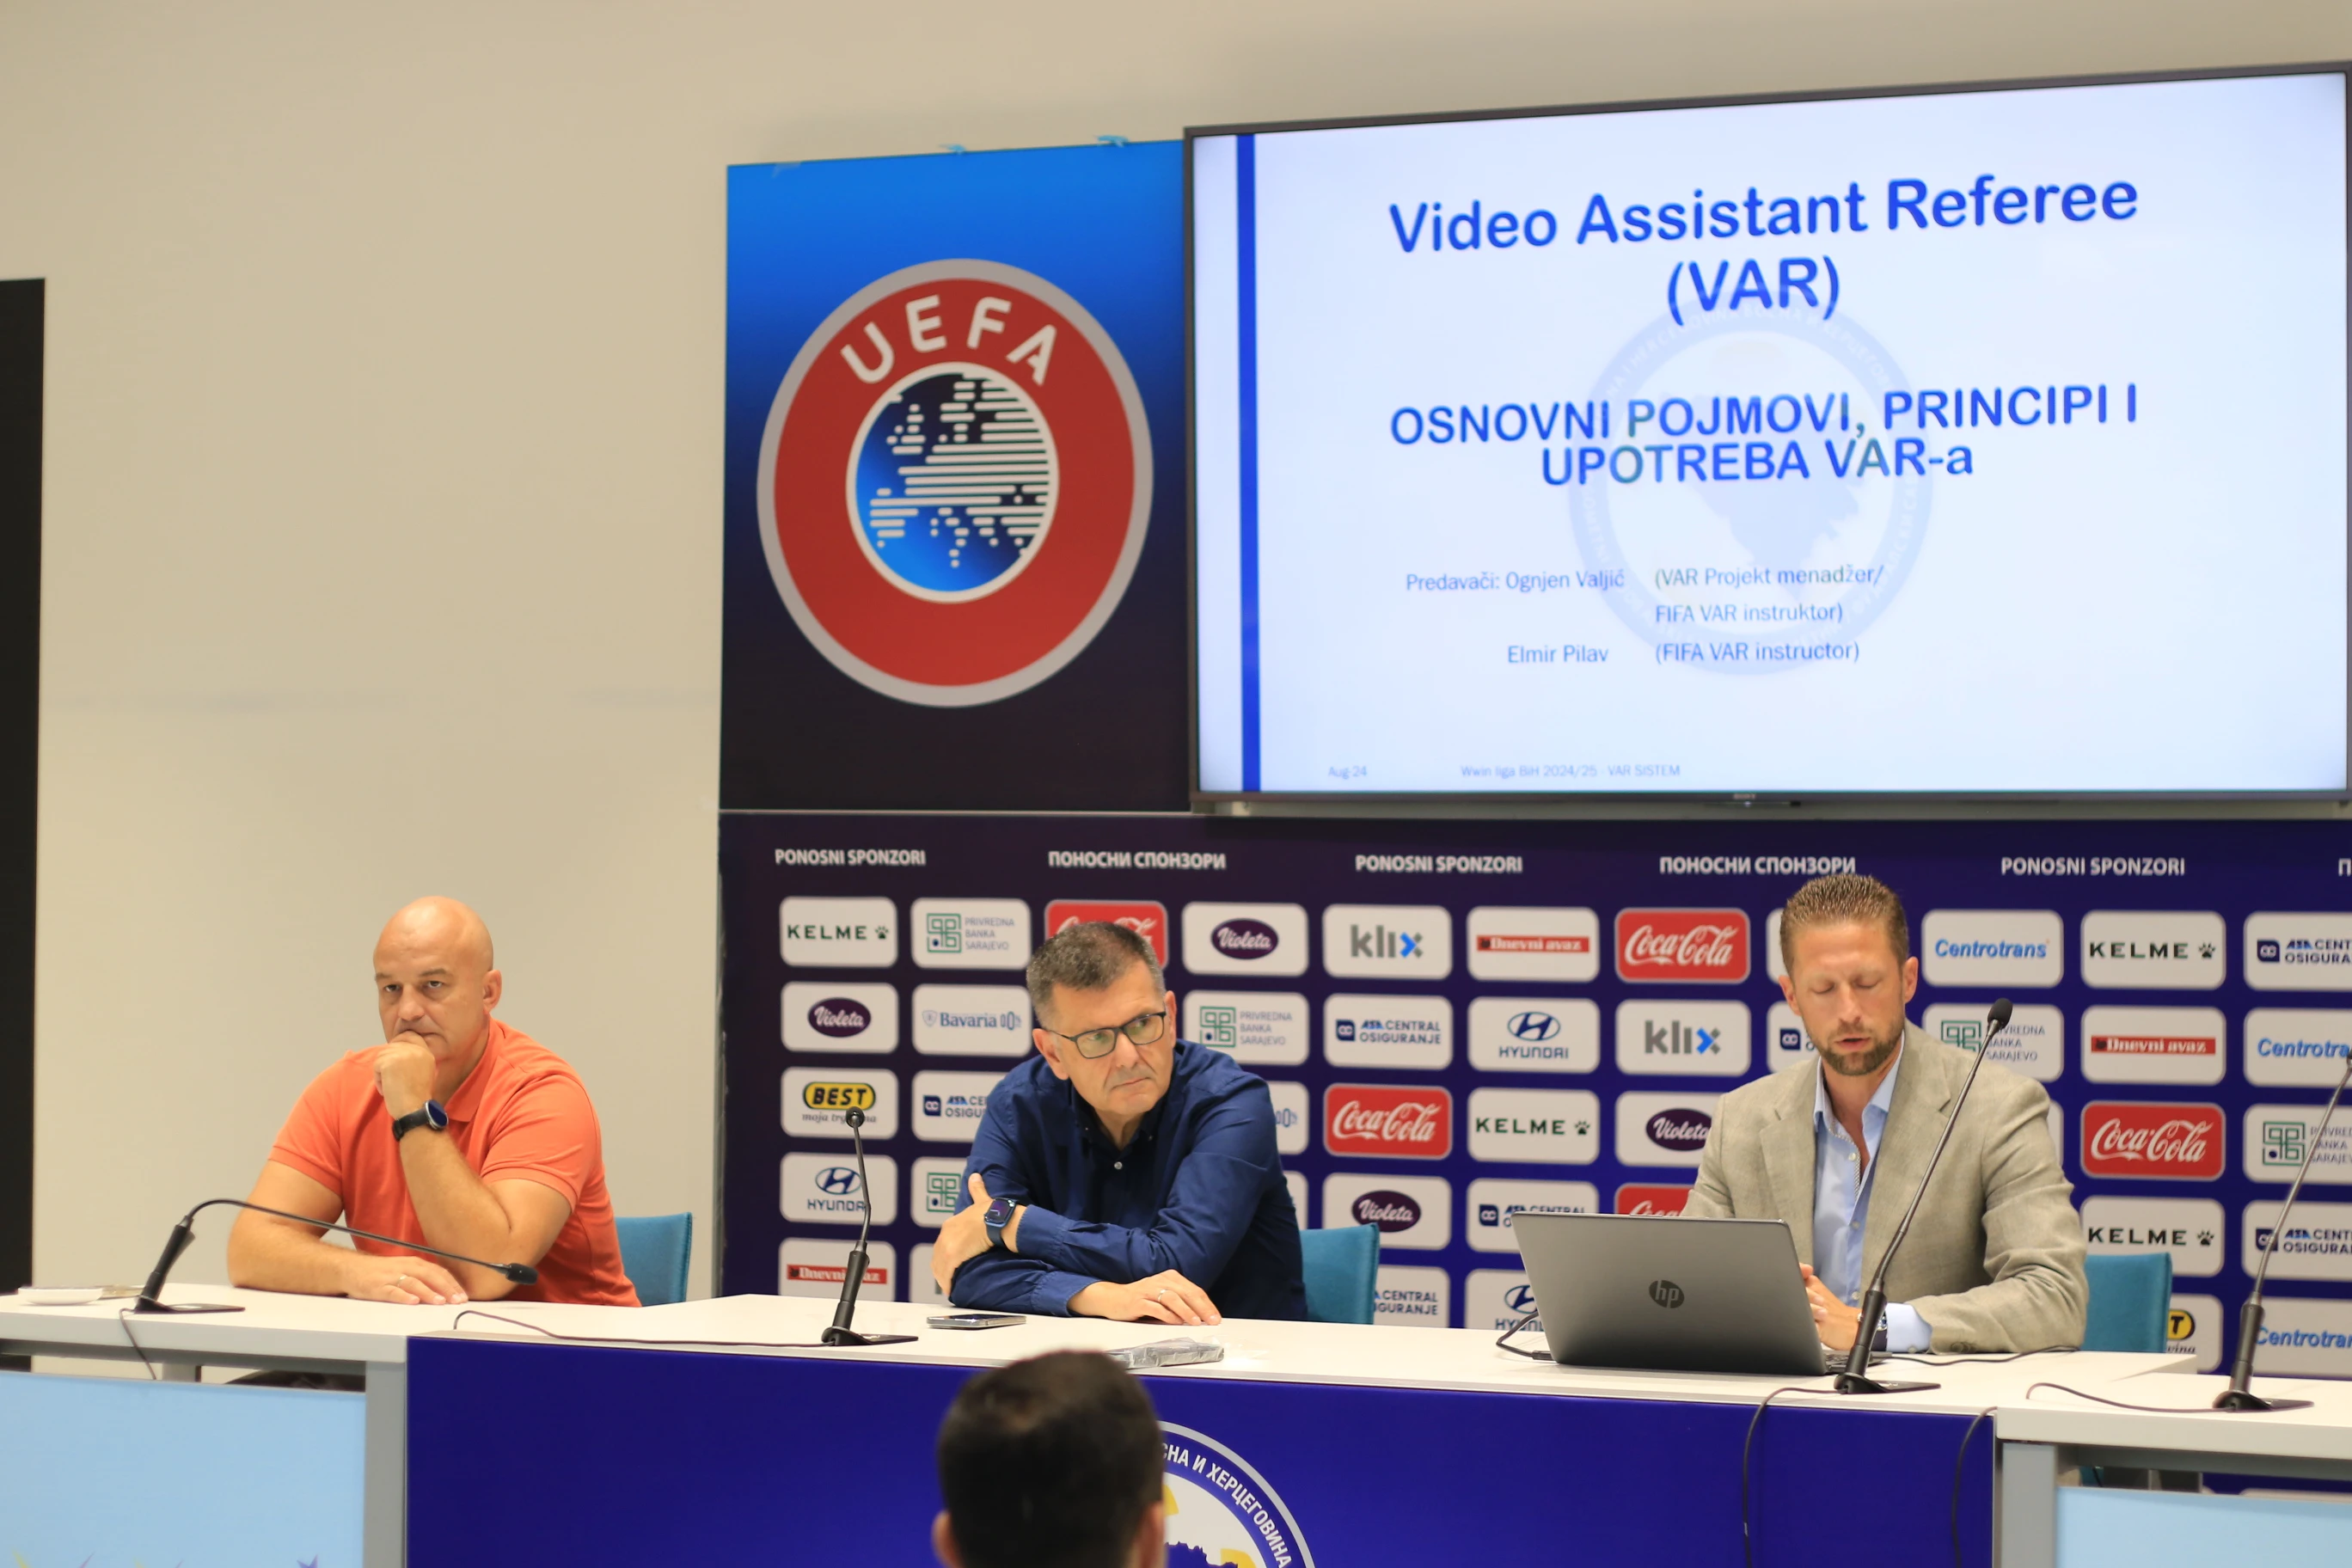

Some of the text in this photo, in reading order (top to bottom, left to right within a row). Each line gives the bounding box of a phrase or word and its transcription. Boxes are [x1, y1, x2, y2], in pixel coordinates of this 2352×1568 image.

[1389, 174, 2139, 254] Video Assistant Referee
[1667, 254, 1841, 325] (VAR)
[841, 295, 1057, 386] UEFA
[1390, 382, 2138, 445] OSNOVNI POJMOVI, PRINCIPI I
[1542, 437, 1975, 487] UPOTREBA VAR-a
[1406, 564, 1885, 593] Predavači: Ognjen Valjić (VAR Projekt menadžer/
[1656, 603, 1695, 624] FIFA
[1700, 603, 1737, 623] VAR
[1743, 601, 1844, 624] instruktor)
[1508, 640, 1860, 665] Elmir Pilav (FIFA VAR instructor)
[1328, 765, 1368, 781] Aug-24
[1461, 765, 1492, 778] Wwin
[1495, 764, 1516, 781] liga
[1519, 764, 1540, 777] BiH
[1543, 764, 1598, 778] 2024/25
[1608, 764, 1632, 777] VAR
[1634, 763, 1681, 777] SISTEM
[775, 848, 927, 867] PONOSNI SPONZORI
[1048, 850, 1227, 870] ПОНОСНИ СПОНЗОРИ
[1355, 854, 1523, 873] PONOSNI SPONZORI
[1659, 856, 1856, 874] ПОНОСНИ СПОНЗОРИ
[2000, 857, 2185, 876] PONOSNI SPONZORI
[965, 916, 1015, 928] PRIVREDNA
[787, 924, 867, 940] KELME
[965, 928, 995, 938] BANKA
[1217, 927, 1271, 950] Violeta
[1350, 923, 1424, 959] klix
[965, 940, 1009, 952] SARAJEVO
[1490, 936, 1582, 952] Dnevni avaz
[1624, 924, 1739, 967] Coca-Cola
[1934, 940, 2048, 959] Centrotrans
[2089, 942, 2189, 959] KELME
[813, 1005, 865, 1027] Violeta
[940, 1011, 997, 1028] Bavaria
[1240, 1010, 1293, 1021] PRIVREDNA
[1240, 1023, 1271, 1033] BANKA
[1386, 1020, 1441, 1032] CENTRAL
[1240, 1035, 1286, 1047] SARAJEVO
[1359, 1032, 1442, 1044] OSIGURANJE
[1644, 1020, 1722, 1055] klix
[2107, 1037, 2207, 1054] Dnevni avaz
[1498, 1046, 1569, 1059] HYUNDAI
[812, 1087, 867, 1106] BEST
[802, 1112, 830, 1124] moja
[1332, 1100, 1442, 1142] Coca-Cola
[1476, 1118, 1565, 1135] KELME
[2091, 1118, 2214, 1162] Coca-Cola
[807, 1198, 866, 1211] HYUNDA
[1358, 1199, 1414, 1222] Violeta
[2088, 1228, 2187, 1246] KELME
[2313, 1229, 2352, 1240] CENT
[2283, 1241, 2352, 1254] OSIGURA
[1382, 1290, 1438, 1302] CENTRAL
[1655, 1280, 1680, 1308] hp
[1192, 1455, 1207, 1473] И
